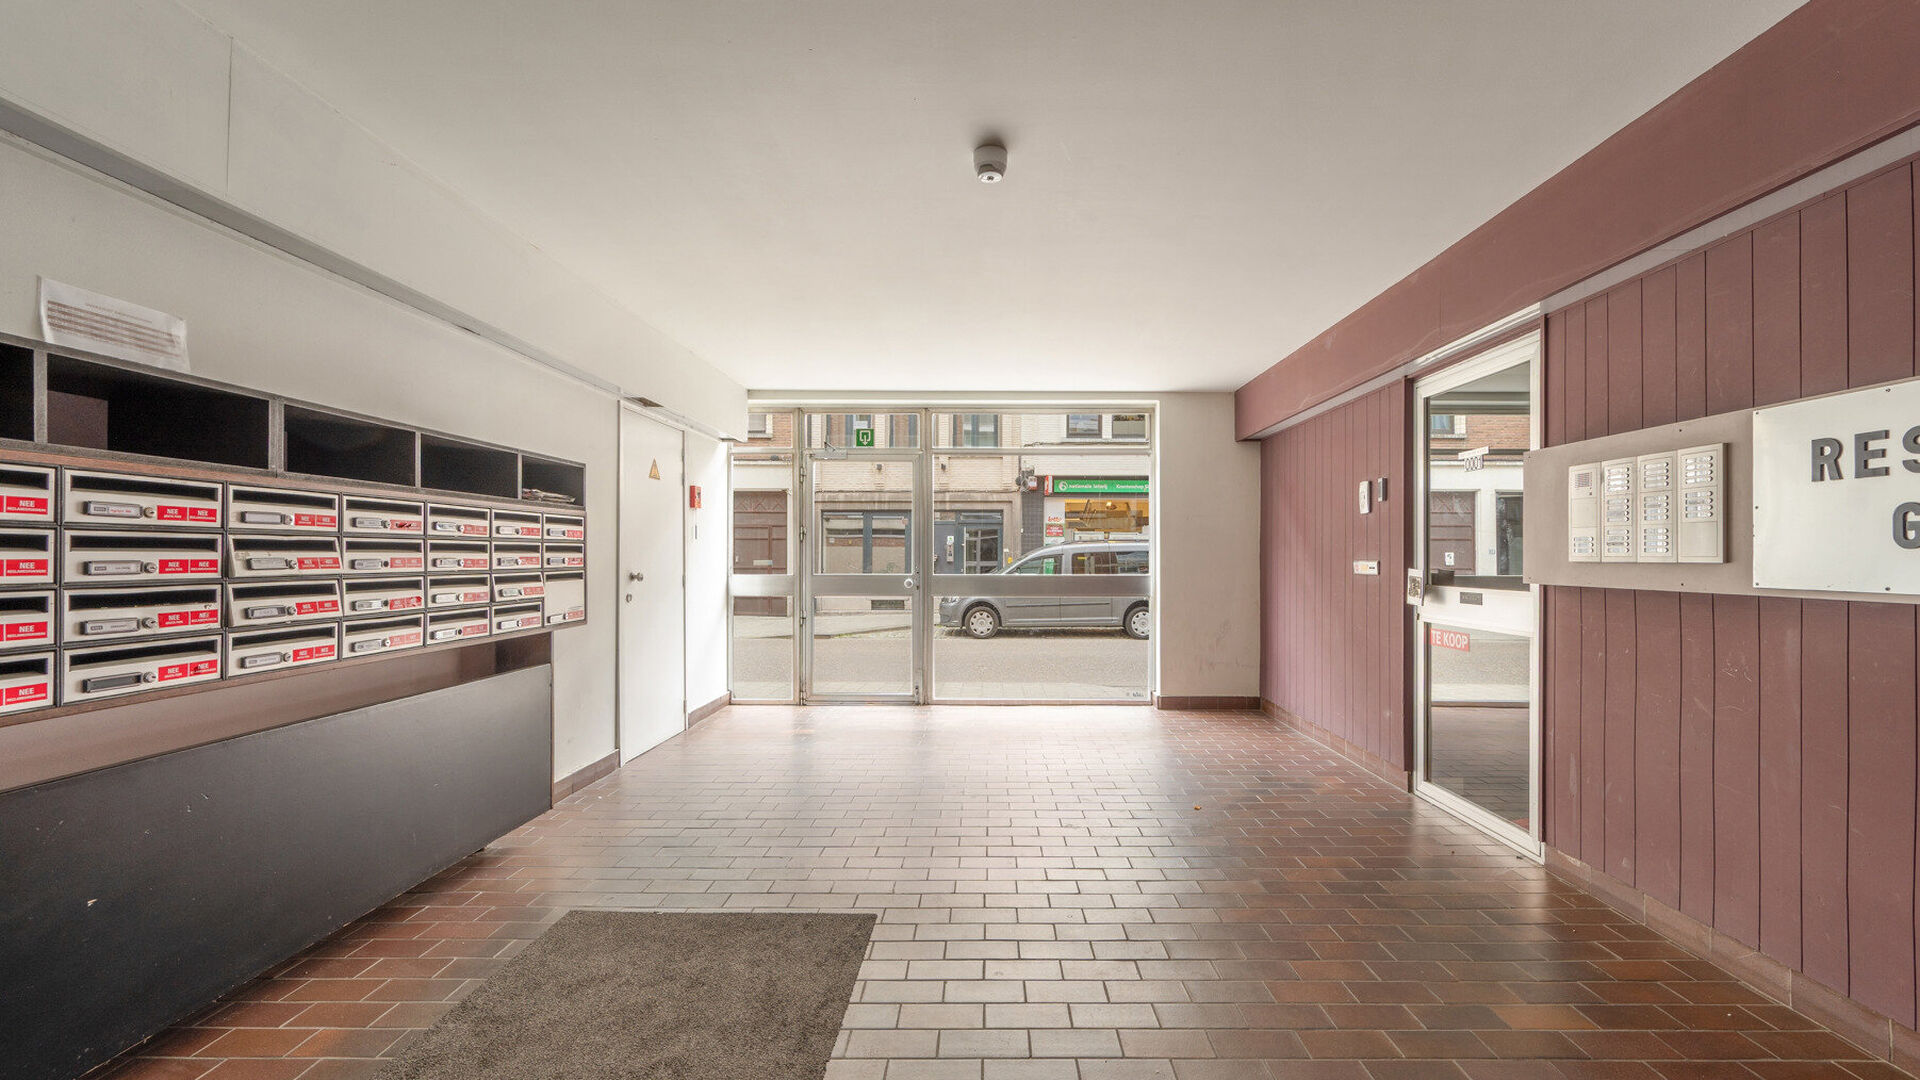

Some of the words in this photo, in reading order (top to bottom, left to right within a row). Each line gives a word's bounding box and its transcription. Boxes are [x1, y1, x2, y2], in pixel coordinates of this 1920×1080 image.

[1892, 502, 1920, 549] G
[1431, 630, 1442, 645] TE
[1443, 631, 1468, 649] KOOP
